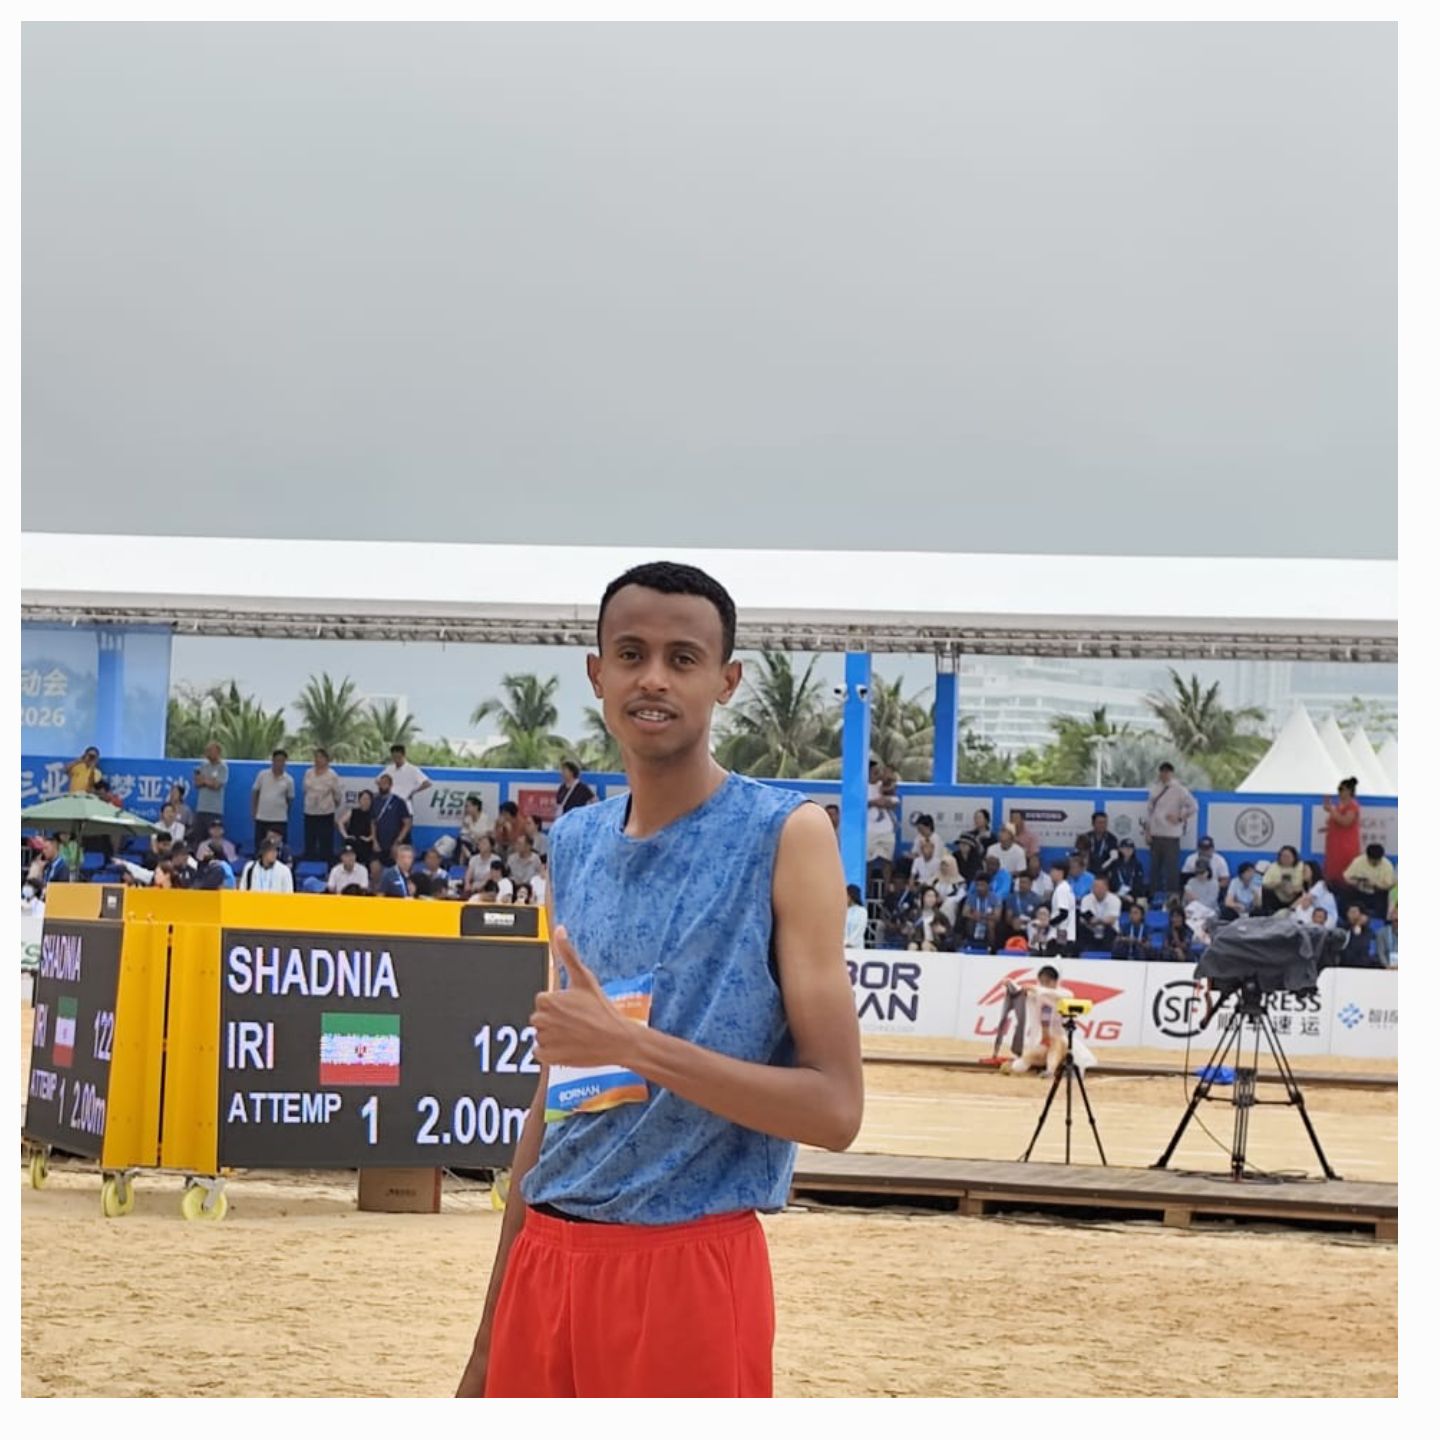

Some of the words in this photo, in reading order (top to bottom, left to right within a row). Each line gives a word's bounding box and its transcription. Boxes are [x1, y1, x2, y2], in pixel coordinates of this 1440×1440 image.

[226, 946, 400, 999] SHADNIA
[93, 1010, 115, 1061] 122
[226, 1021, 275, 1070] IRI
[474, 1025, 542, 1074] 122
[59, 1077, 66, 1124] 1
[71, 1080, 106, 1137] 2.00m
[228, 1092, 342, 1125] ATTEMP
[361, 1096, 380, 1145] 1
[558, 1083, 601, 1103] BORNAN
